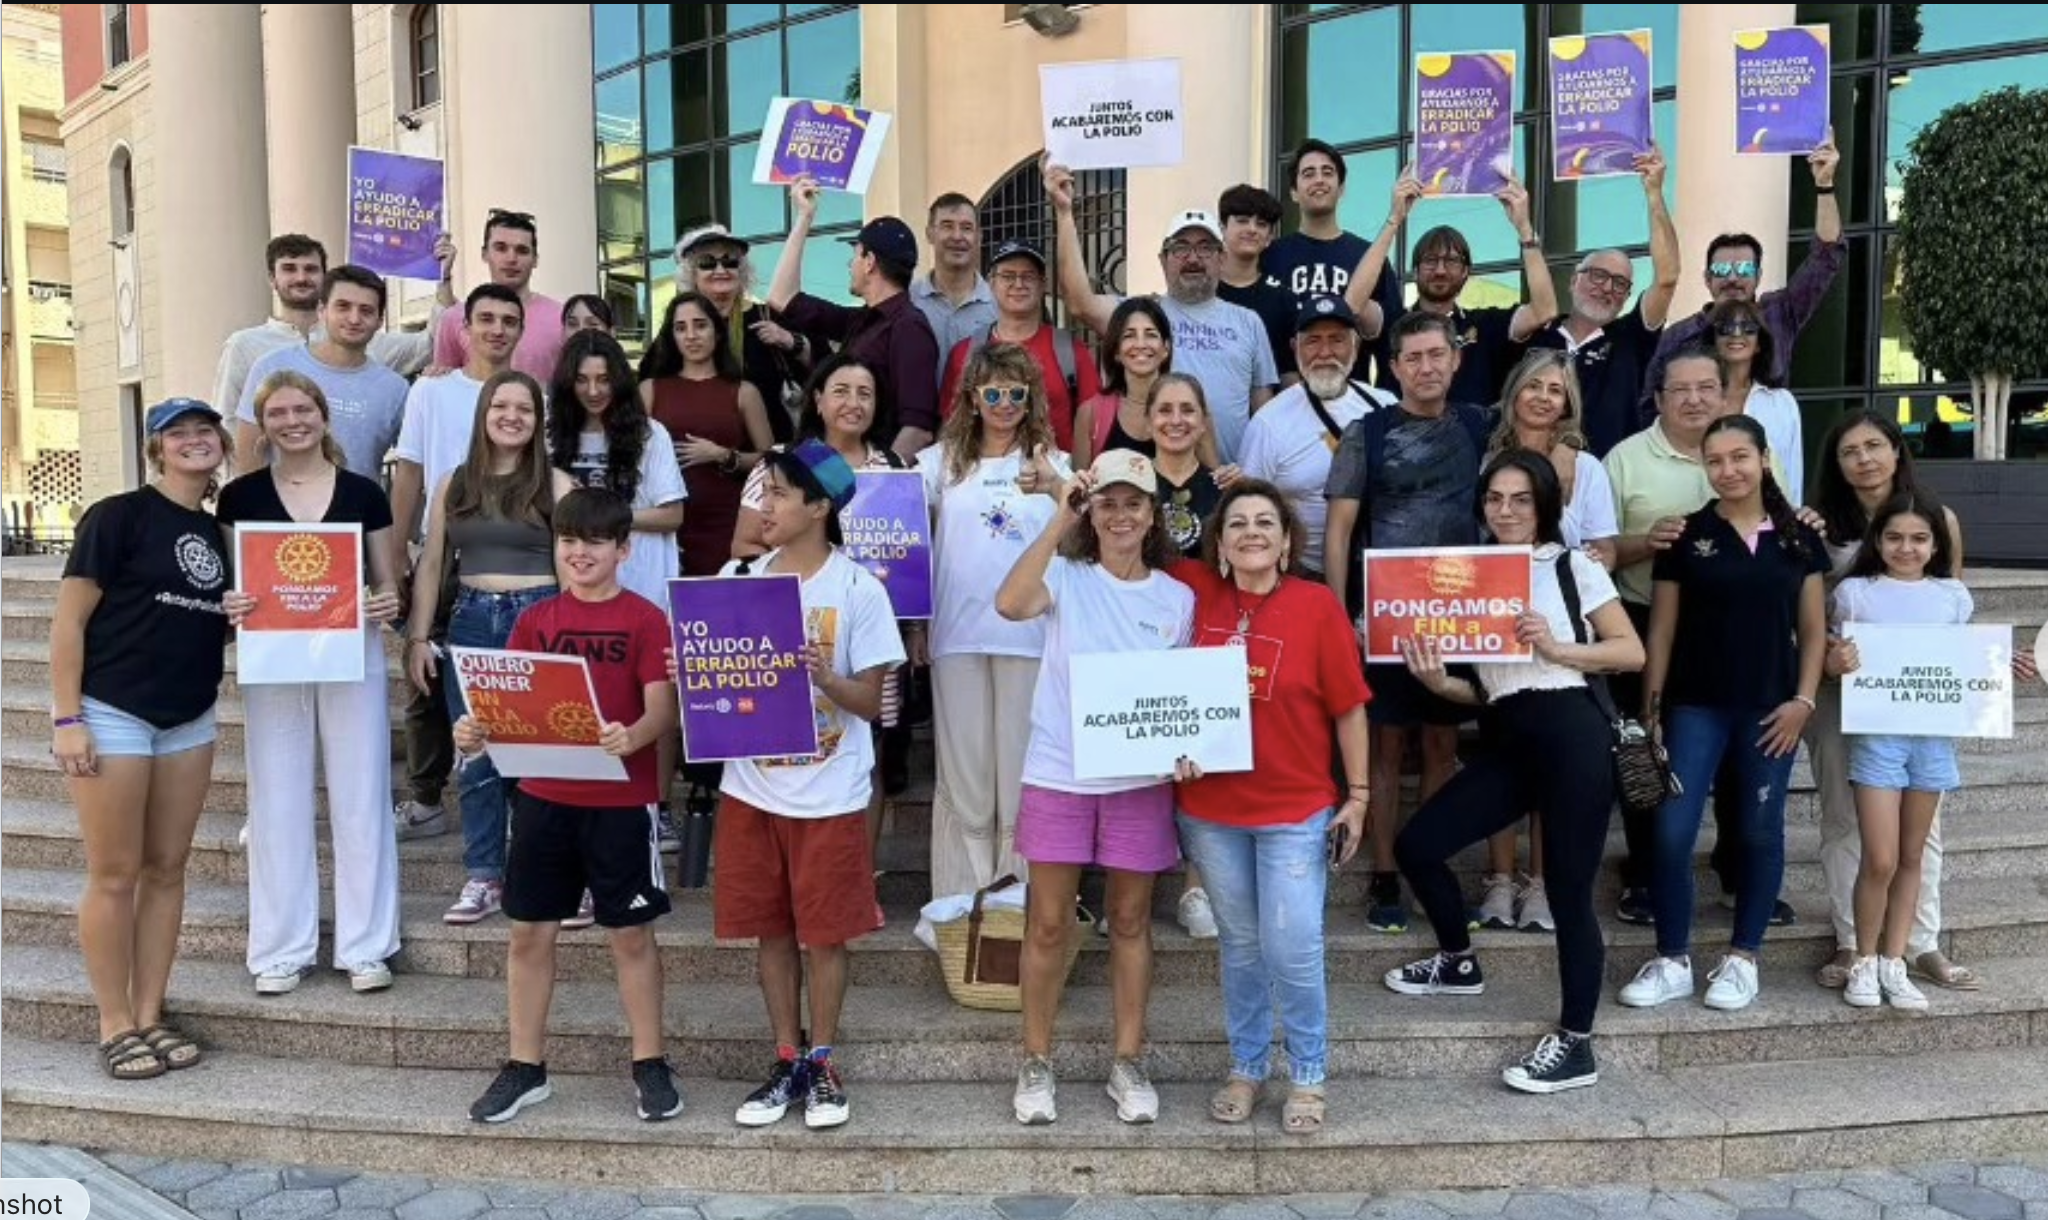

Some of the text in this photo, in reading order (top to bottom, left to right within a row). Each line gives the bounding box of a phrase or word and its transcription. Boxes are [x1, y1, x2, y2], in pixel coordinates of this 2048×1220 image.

[1786, 56, 1809, 66] POR
[1606, 66, 1629, 77] POR
[1808, 65, 1817, 75] A
[1629, 75, 1638, 86] A
[1740, 75, 1812, 87] ERRADICAR
[1421, 87, 1492, 98] GRACIAS POR
[1558, 87, 1632, 103] ERRADICAR
[1740, 85, 1800, 98] LA POLIO
[1090, 100, 1132, 113] JUNTOS
[1421, 97, 1499, 108] AYUDARNOS A
[1558, 100, 1620, 115] LA POLIO
[1052, 109, 1174, 128] ACABAREMOS CON
[1421, 108, 1495, 120] ERRADICAR
[1083, 124, 1142, 139] LA POLIO
[1421, 121, 1480, 133] LA POLIO
[786, 142, 844, 163] POLIO
[354, 176, 375, 190] YO
[354, 189, 420, 208] AYUDO A
[354, 201, 435, 221] ERRADICAR
[354, 212, 420, 231] LA POLIO
[1291, 263, 1348, 294] GAP
[841, 516, 905, 531] YUDO A
[843, 531, 921, 546] RRADICAR
[859, 545, 907, 559] POLIO
[271, 585, 338, 594] PONGAMOS
[1373, 597, 1523, 618] PONGAMOS
[680, 621, 708, 637] YO
[1414, 617, 1481, 634] FIN a
[537, 629, 629, 665] VANS
[683, 635, 773, 655] AYUDO A
[459, 654, 535, 675] QUIERO
[685, 652, 796, 672] ERRADICAR
[1901, 666, 1952, 678] JUNTOS
[461, 673, 532, 692] PONER
[687, 671, 778, 690] LA POLIO
[1853, 676, 2003, 692] ACABAREMOS CON
[1134, 695, 1188, 710] JUNTOS
[1891, 690, 1962, 704] LA POLIO
[492, 708, 521, 723] LA
[1083, 707, 1240, 727] ACABAREMOS CON
[1126, 723, 1200, 739] LA POLIO
